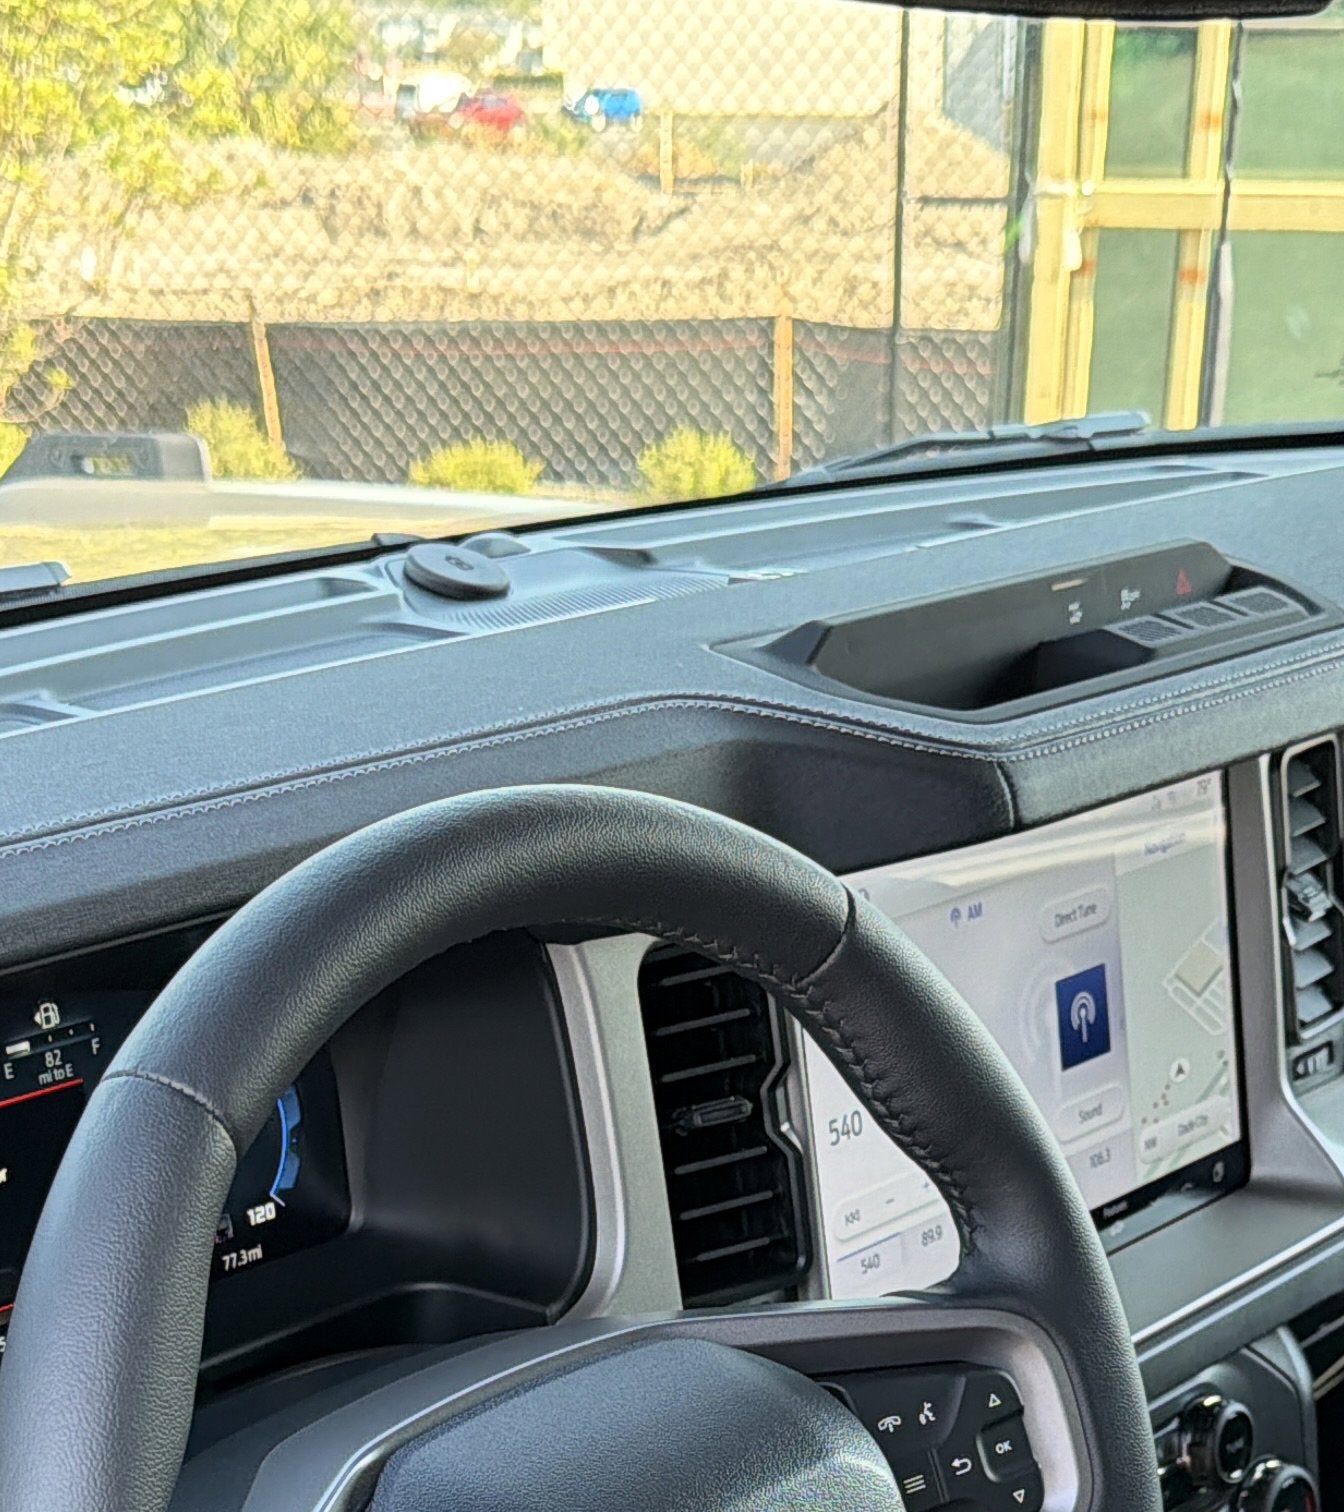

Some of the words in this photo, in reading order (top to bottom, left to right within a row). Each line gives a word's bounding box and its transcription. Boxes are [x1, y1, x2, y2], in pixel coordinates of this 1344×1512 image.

[967, 902, 983, 921] AM
[91, 1037, 101, 1055] F
[45, 1050, 62, 1068] 82
[3, 1062, 15, 1080] E
[828, 1110, 863, 1146] 540
[246, 1201, 277, 1227] 120
[921, 1225, 943, 1247] 89.9
[860, 1253, 880, 1275] 540
[995, 1440, 1013, 1454] OK
